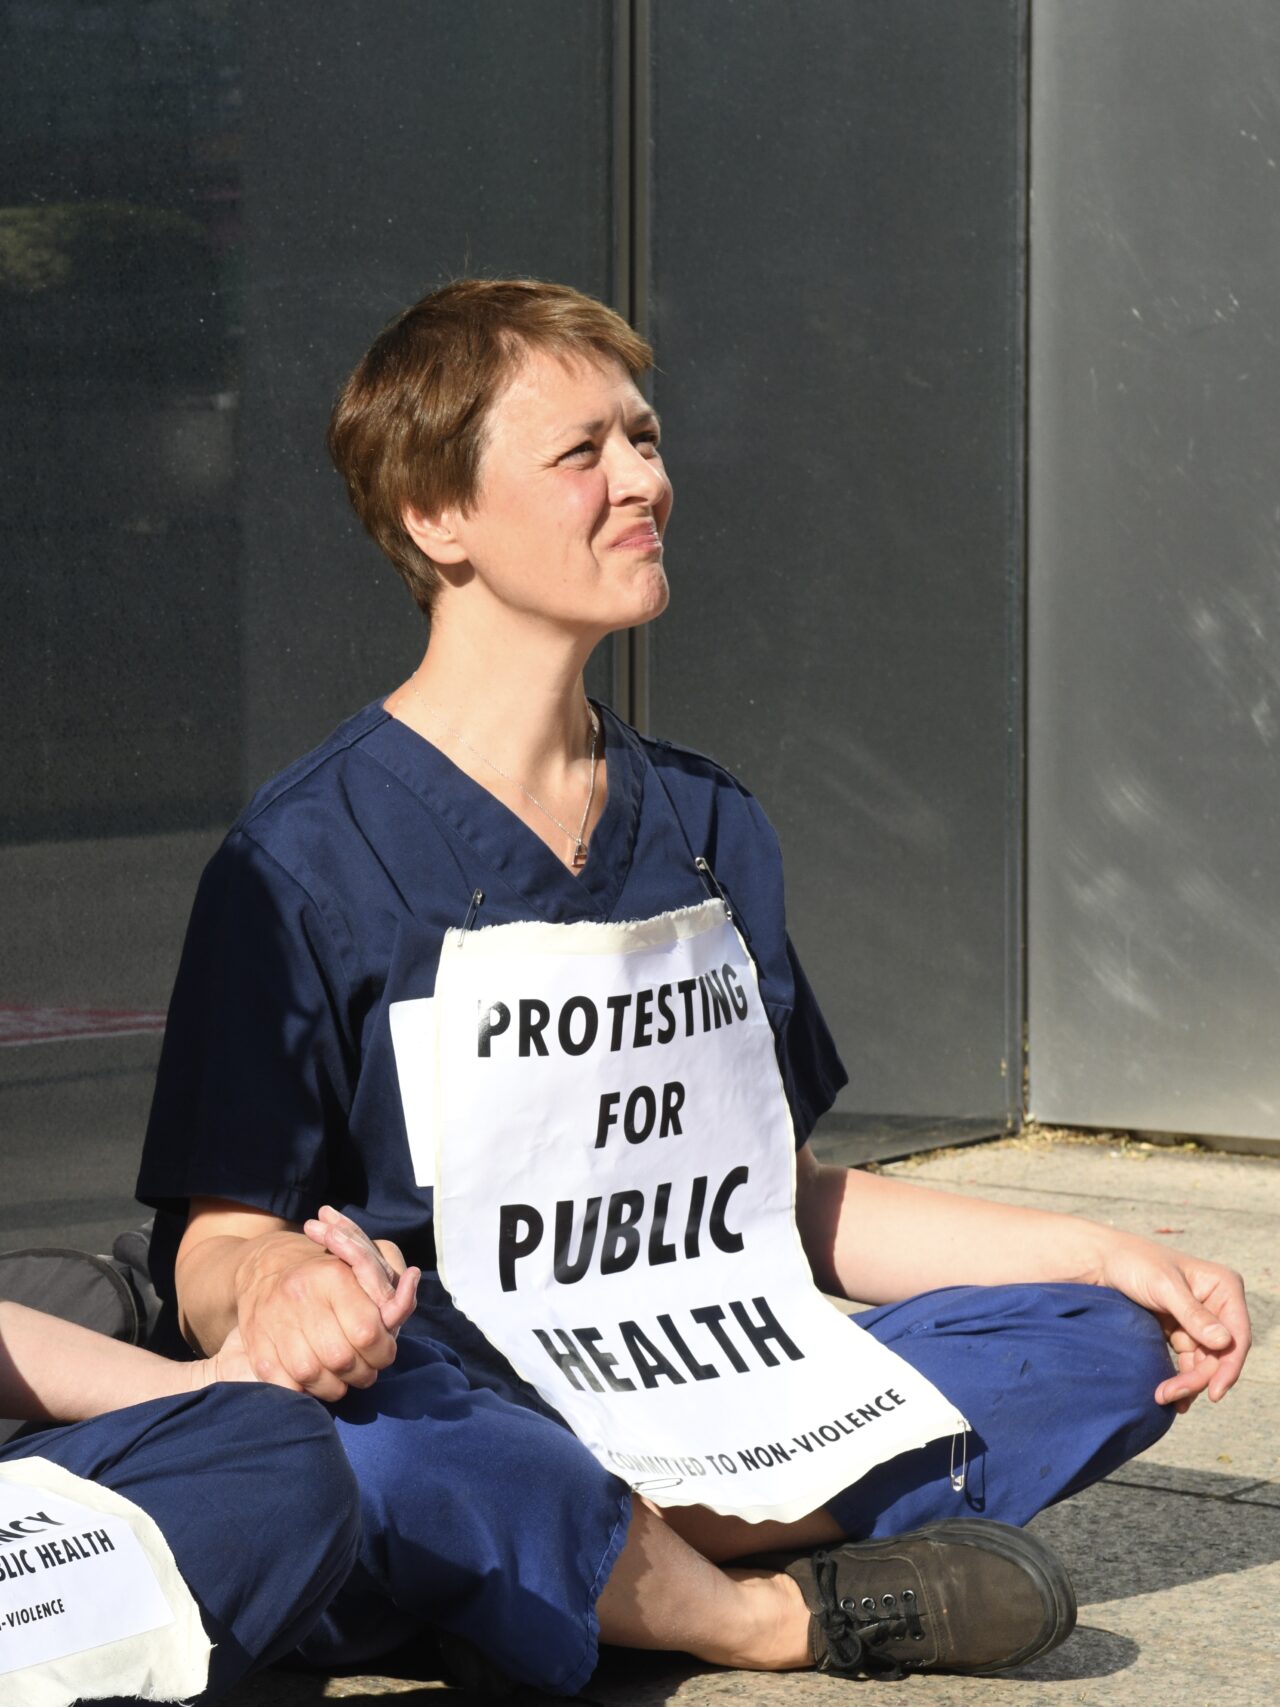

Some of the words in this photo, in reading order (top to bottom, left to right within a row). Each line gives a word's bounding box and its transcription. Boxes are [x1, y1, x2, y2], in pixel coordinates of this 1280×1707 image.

[477, 963, 748, 1057] PROTESTING
[594, 1081, 686, 1148] FOR
[498, 1166, 749, 1292] PUBLIC
[532, 1297, 806, 1392] HEALTH
[608, 1450, 707, 1477] COMMITTED
[706, 1454, 738, 1476] TO
[737, 1388, 907, 1471] NON-VIOLENCE
[35, 1528, 116, 1569] HEALTH
